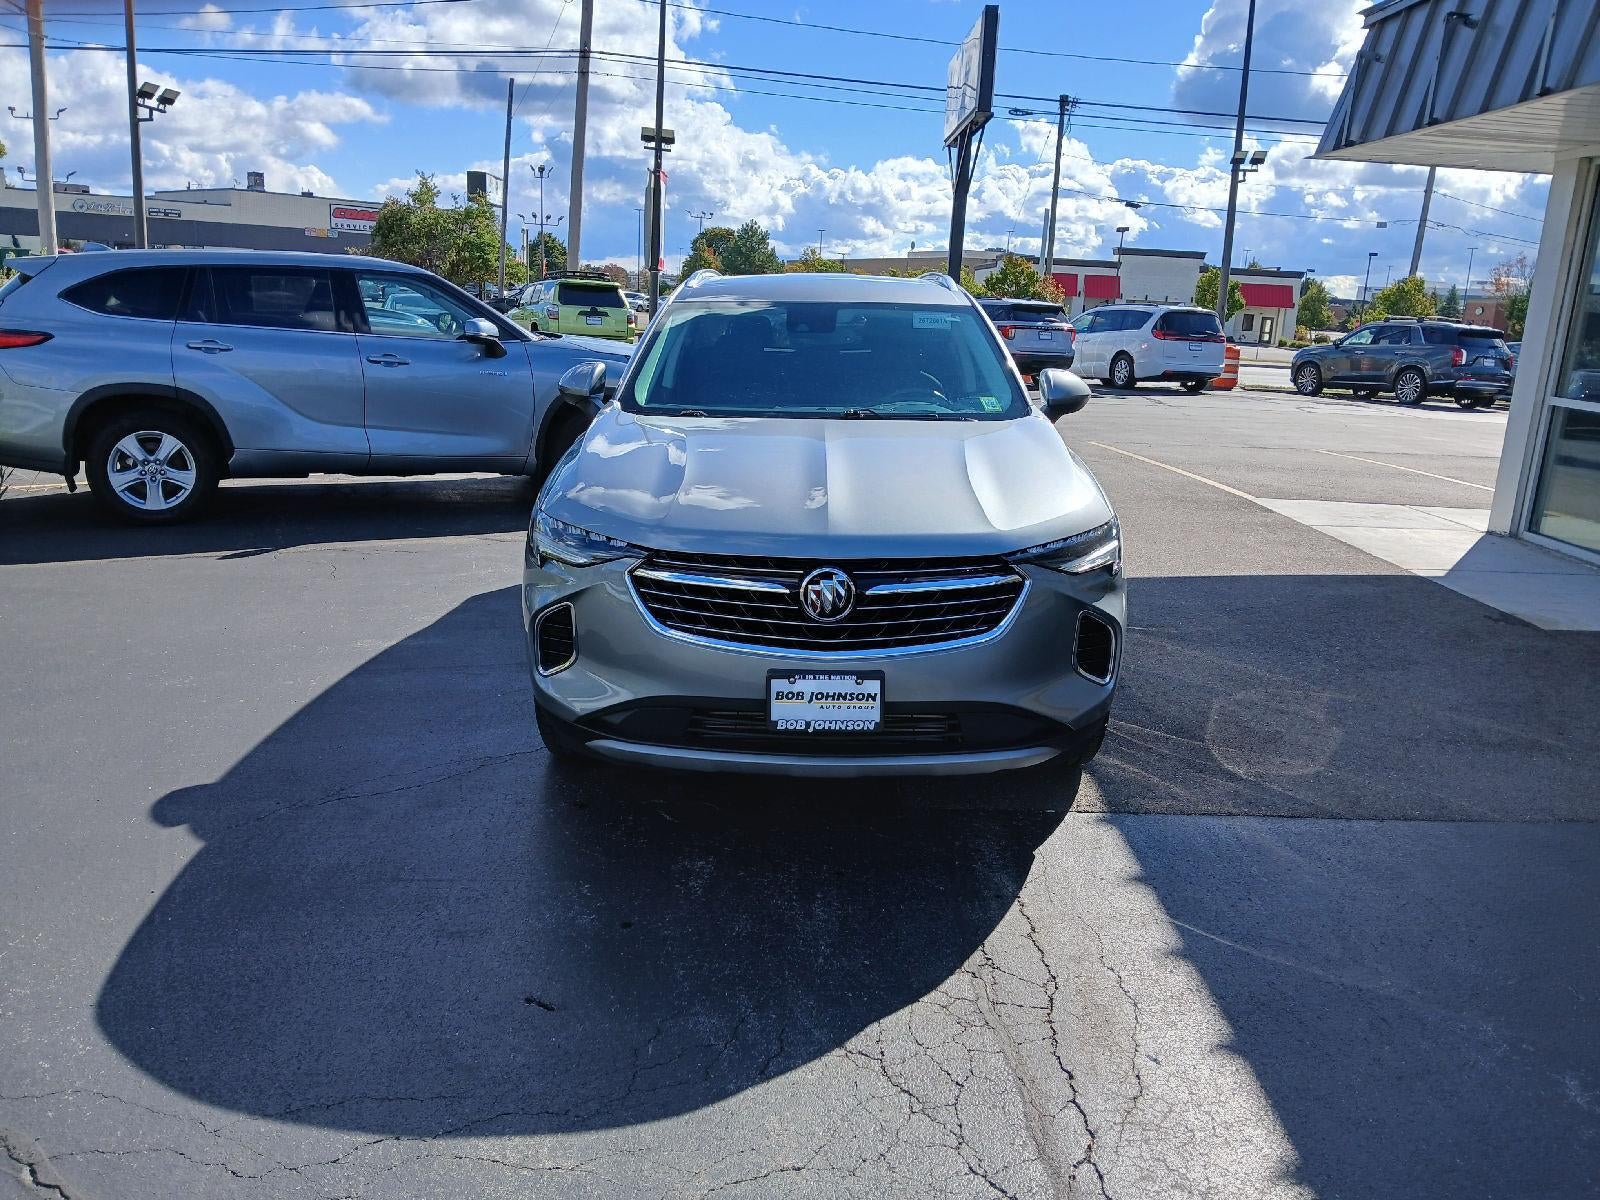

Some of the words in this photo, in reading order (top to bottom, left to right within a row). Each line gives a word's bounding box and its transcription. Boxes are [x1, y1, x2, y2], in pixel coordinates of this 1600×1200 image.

[774, 690, 805, 701] BOB
[808, 691, 878, 704] JOHNSON
[776, 719, 806, 730] BOB
[808, 720, 876, 732] JOHNSON
